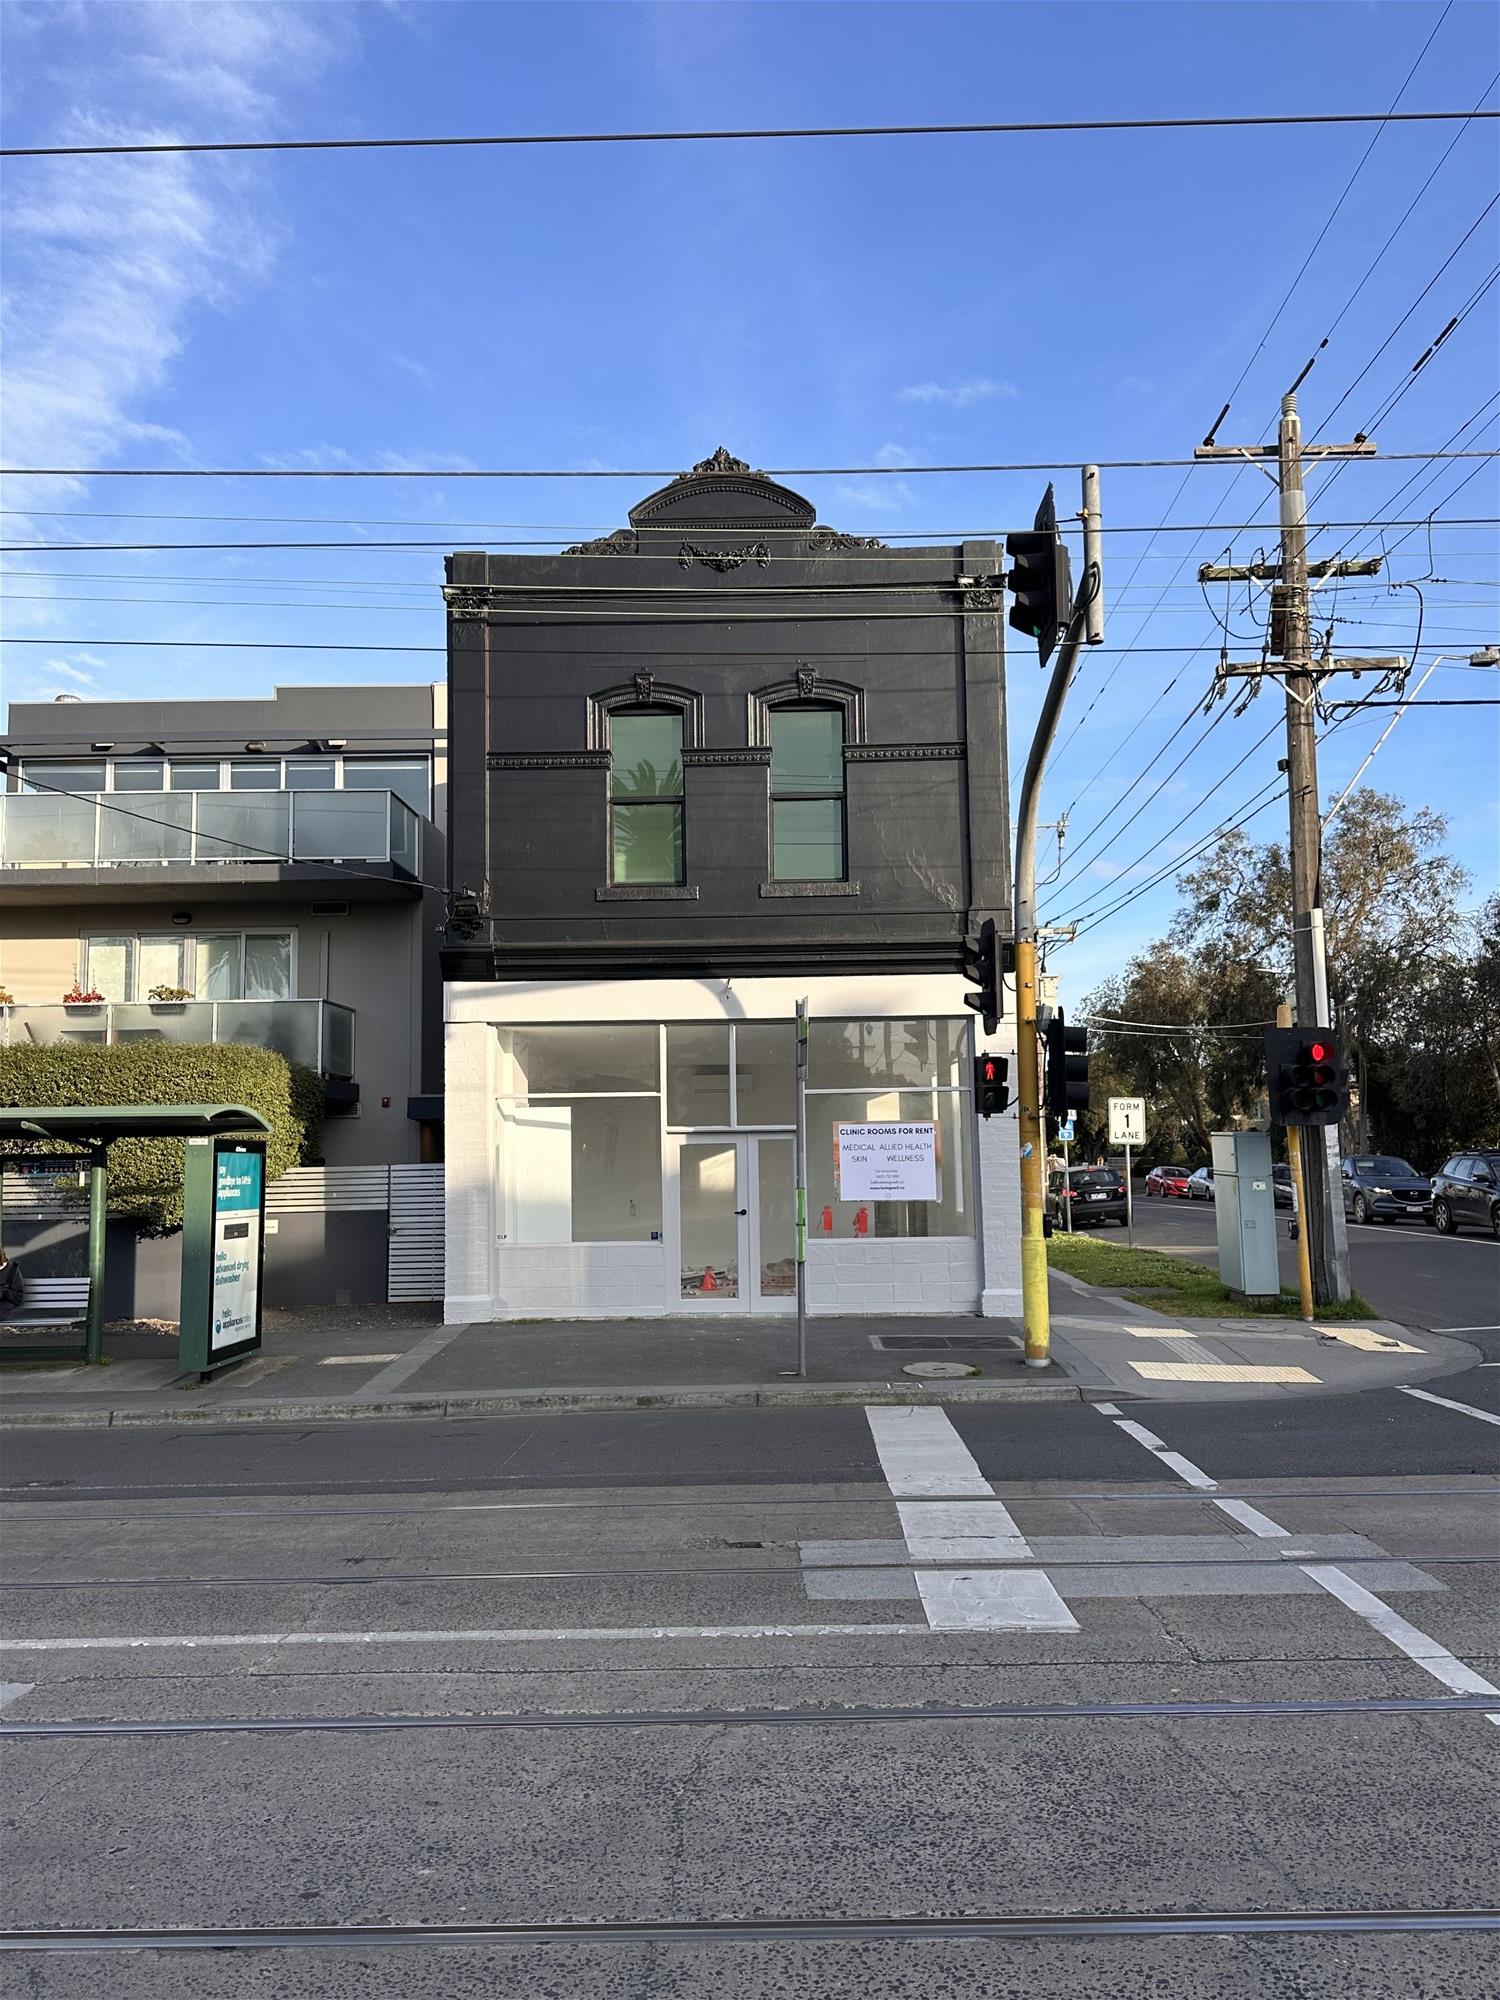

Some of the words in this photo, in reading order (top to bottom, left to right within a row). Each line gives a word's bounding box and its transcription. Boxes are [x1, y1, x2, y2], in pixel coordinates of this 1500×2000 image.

[1113, 1102, 1140, 1111] FORM
[1124, 1113, 1130, 1128] 1
[840, 1128, 865, 1136] CLINIC
[898, 1127, 914, 1135] FOR
[915, 1127, 934, 1135] RENT
[1114, 1131, 1141, 1140] LANE
[879, 1143, 903, 1151] ALLIED
[851, 1155, 868, 1163] SKIN
[886, 1154, 925, 1162] WELLNESS
